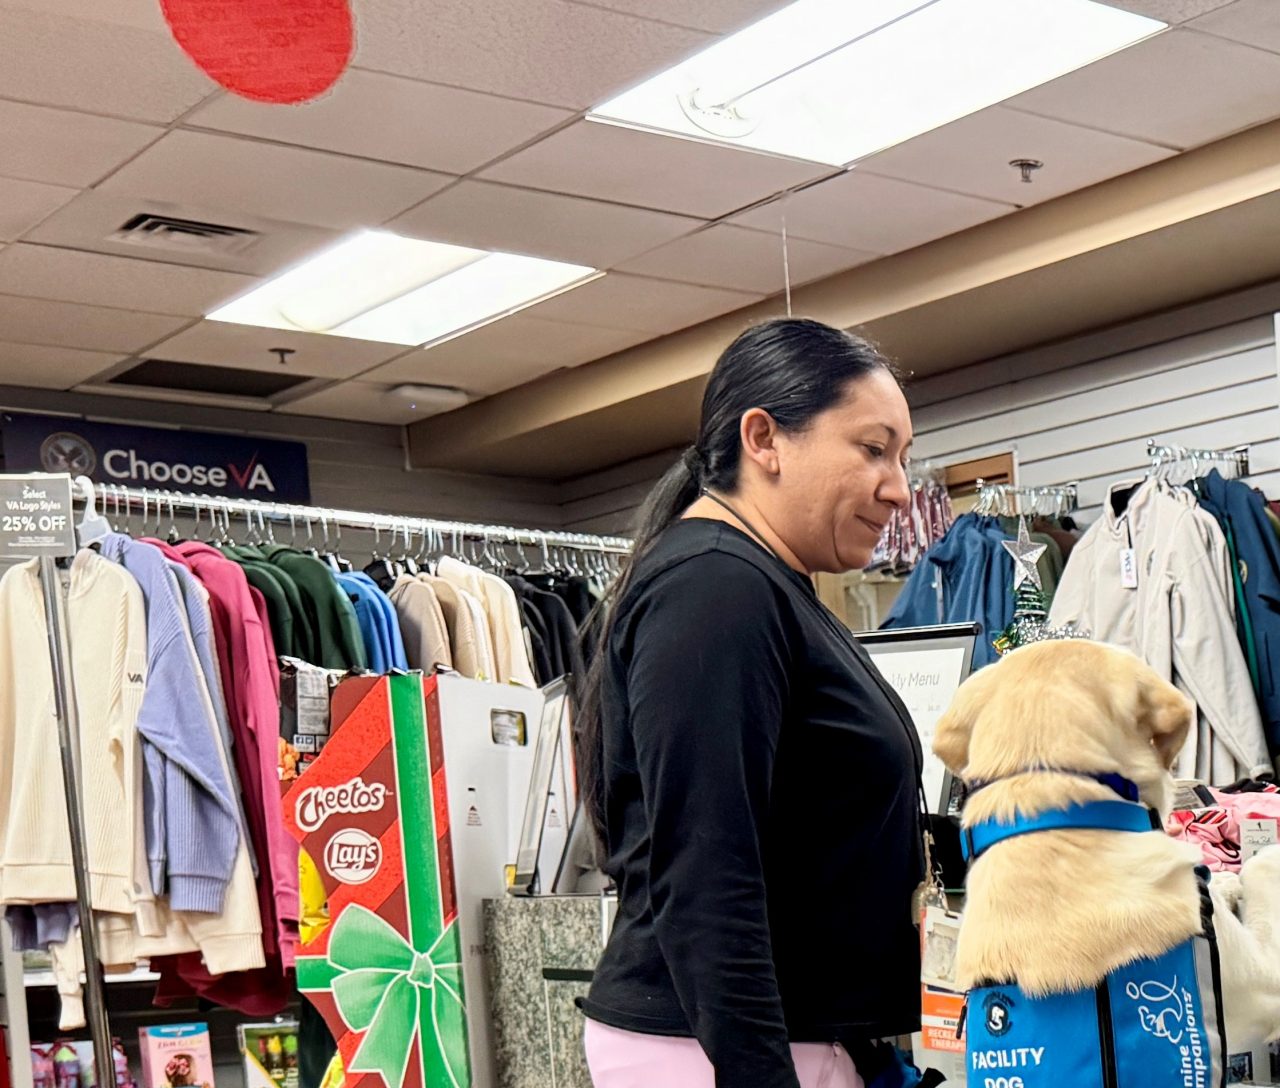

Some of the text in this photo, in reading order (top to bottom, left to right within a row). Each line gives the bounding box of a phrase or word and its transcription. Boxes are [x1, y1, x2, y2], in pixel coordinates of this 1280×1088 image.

[103, 450, 227, 487] Choose
[23, 488, 46, 499] Select
[6, 501, 61, 512] VA Logo Styles
[2, 516, 66, 531] 25% OFF
[128, 673, 143, 683] VA
[908, 673, 940, 686] Menu
[299, 780, 383, 826] Cheetos
[331, 844, 377, 870] Lay's
[972, 1047, 1045, 1070] FACILITY
